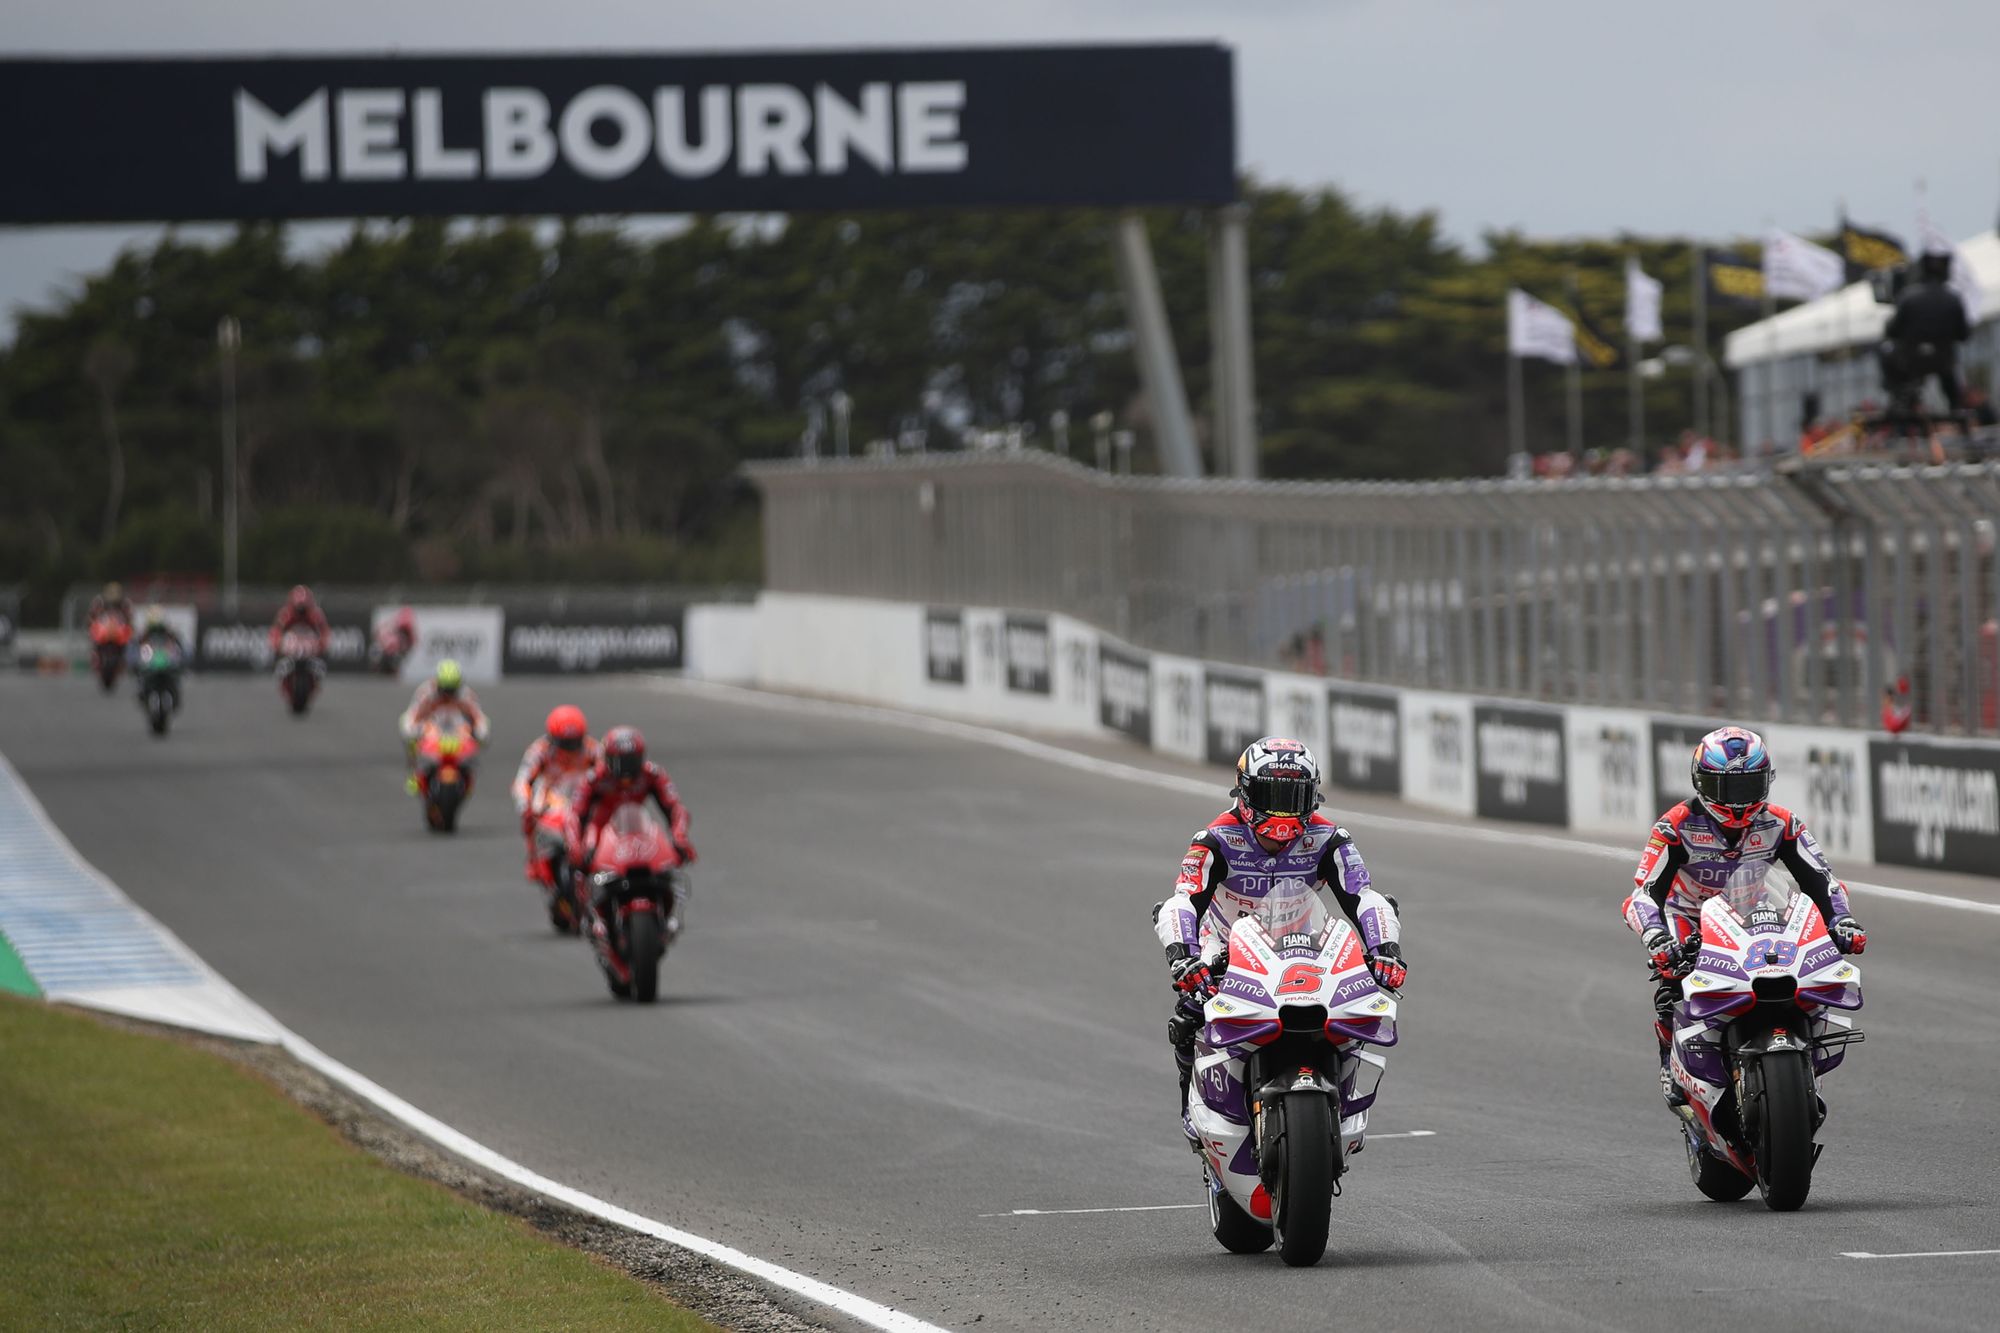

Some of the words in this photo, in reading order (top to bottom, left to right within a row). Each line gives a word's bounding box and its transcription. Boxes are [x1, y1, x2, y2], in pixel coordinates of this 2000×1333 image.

[234, 81, 967, 181] MELBOURNE
[1268, 762, 1303, 770] SHARK
[1226, 835, 1246, 846] FIAMM
[1691, 834, 1714, 843] FIAMM
[1230, 860, 1256, 868] SHARK
[1696, 865, 1765, 882] prima
[1240, 876, 1306, 893] prima
[1752, 911, 1778, 924] FIAMM
[1803, 909, 1820, 940] PRAMAC
[1366, 916, 1378, 940] prima
[1704, 916, 1732, 946] PRAMAC
[1752, 924, 1781, 935] prima
[1283, 934, 1311, 947] FIAMM
[1233, 937, 1261, 970] PRAMAC
[1282, 948, 1313, 960] prima
[1337, 936, 1357, 969] PRAMAC
[1743, 939, 1799, 971] 89
[1804, 946, 1839, 969] prima
[1698, 955, 1739, 972] prima
[1222, 978, 1266, 998] prima
[1337, 976, 1376, 999] prima
